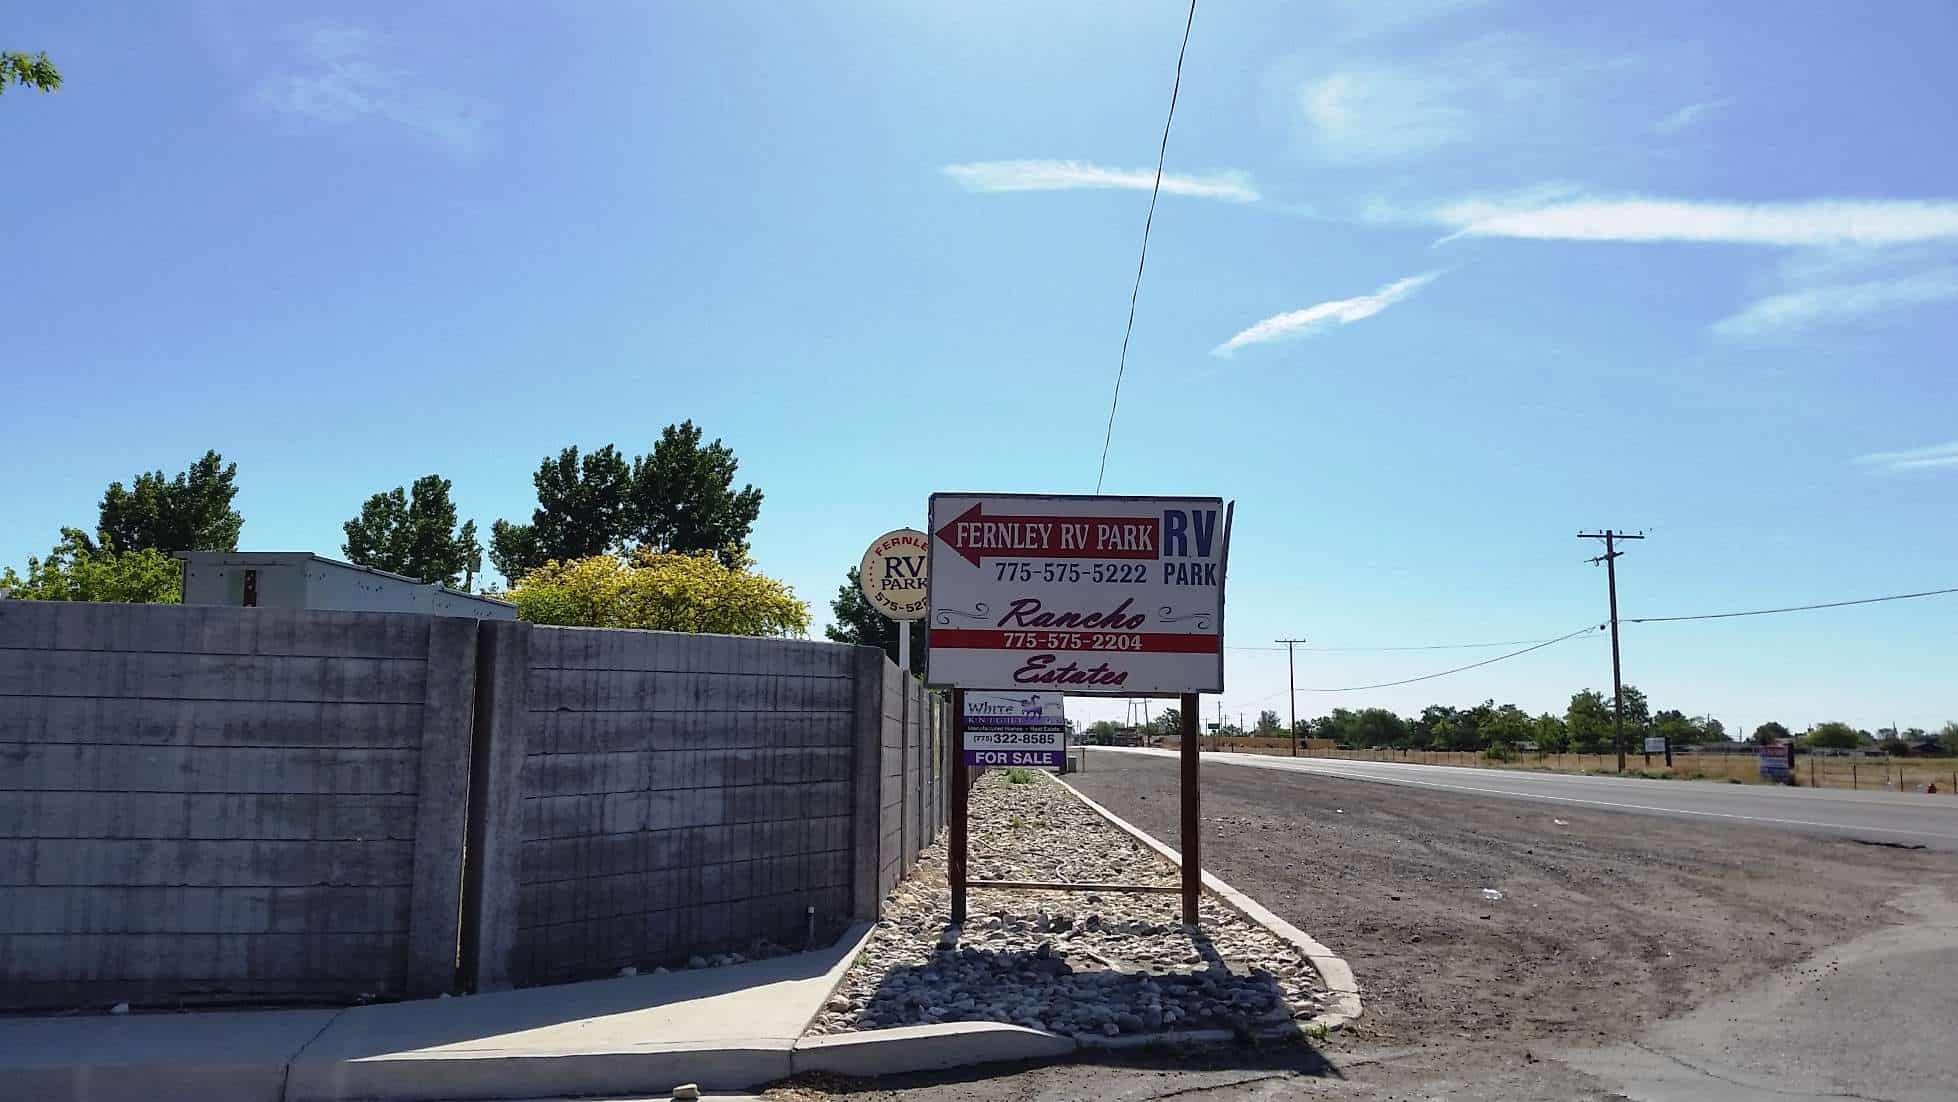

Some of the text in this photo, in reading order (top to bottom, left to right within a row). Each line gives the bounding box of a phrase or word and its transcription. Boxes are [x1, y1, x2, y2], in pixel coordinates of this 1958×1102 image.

[955, 522, 1153, 551] FERNLEY RV PARK
[1162, 509, 1217, 558] RV
[874, 535, 929, 557] FERNLE
[883, 556, 926, 578] RV
[995, 561, 1147, 584] 775-575-5222
[1163, 562, 1217, 586] PARK
[881, 577, 929, 590] PARK
[874, 591, 929, 612] 575-522
[997, 597, 1147, 630] Rancho
[1003, 632, 1144, 651] 775-575-2204
[1013, 653, 1129, 686] Estates
[968, 701, 1015, 715] White
[975, 752, 1053, 764] FOR SALE
